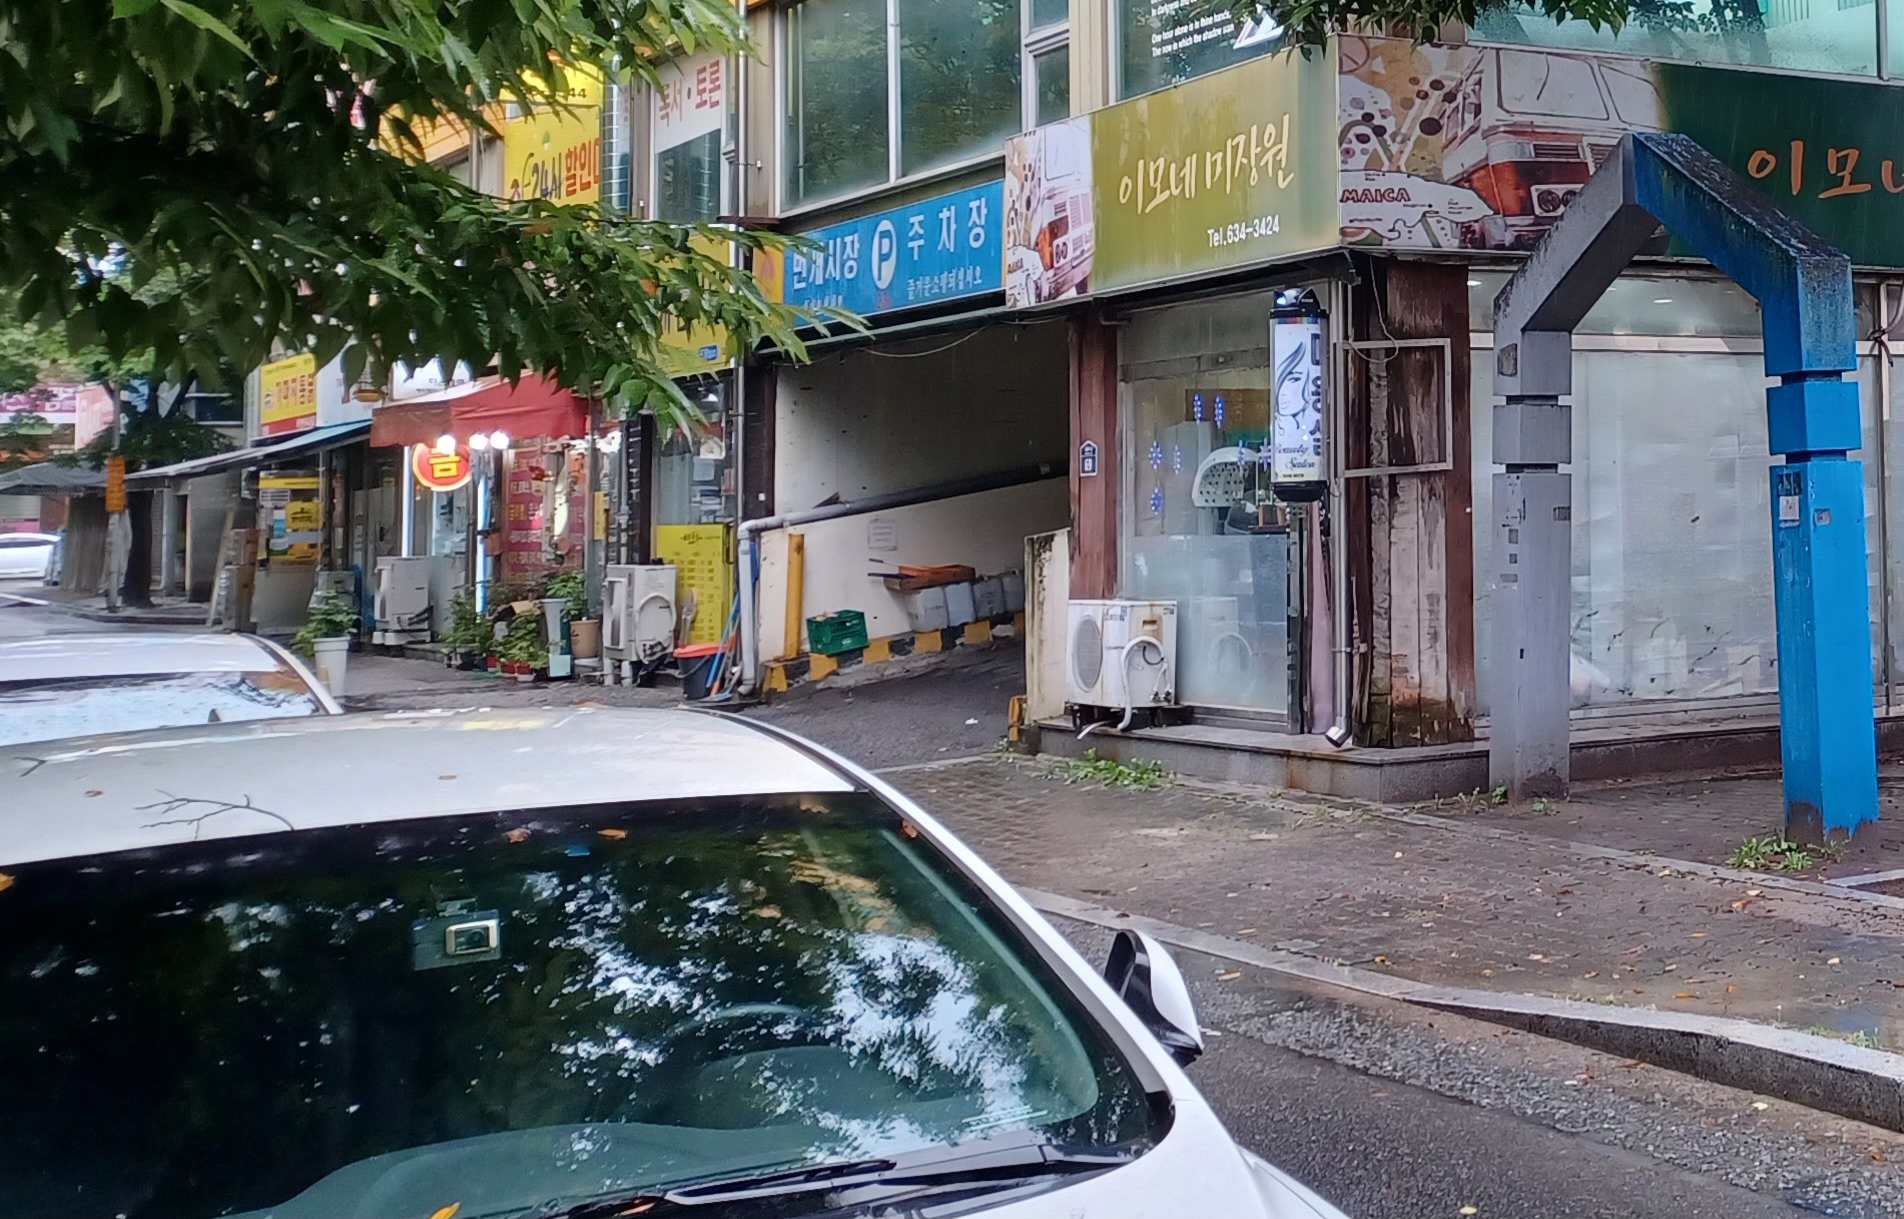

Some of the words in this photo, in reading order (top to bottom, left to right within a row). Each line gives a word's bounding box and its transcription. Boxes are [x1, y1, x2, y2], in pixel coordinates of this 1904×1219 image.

[695, 59, 721, 110] 토론
[1119, 152, 1197, 214] 이모네
[1205, 113, 1295, 195] 미장원
[1339, 187, 1411, 203] MAICA
[907, 197, 988, 261] 주차장
[1207, 214, 1280, 248] Tel.634-3424
